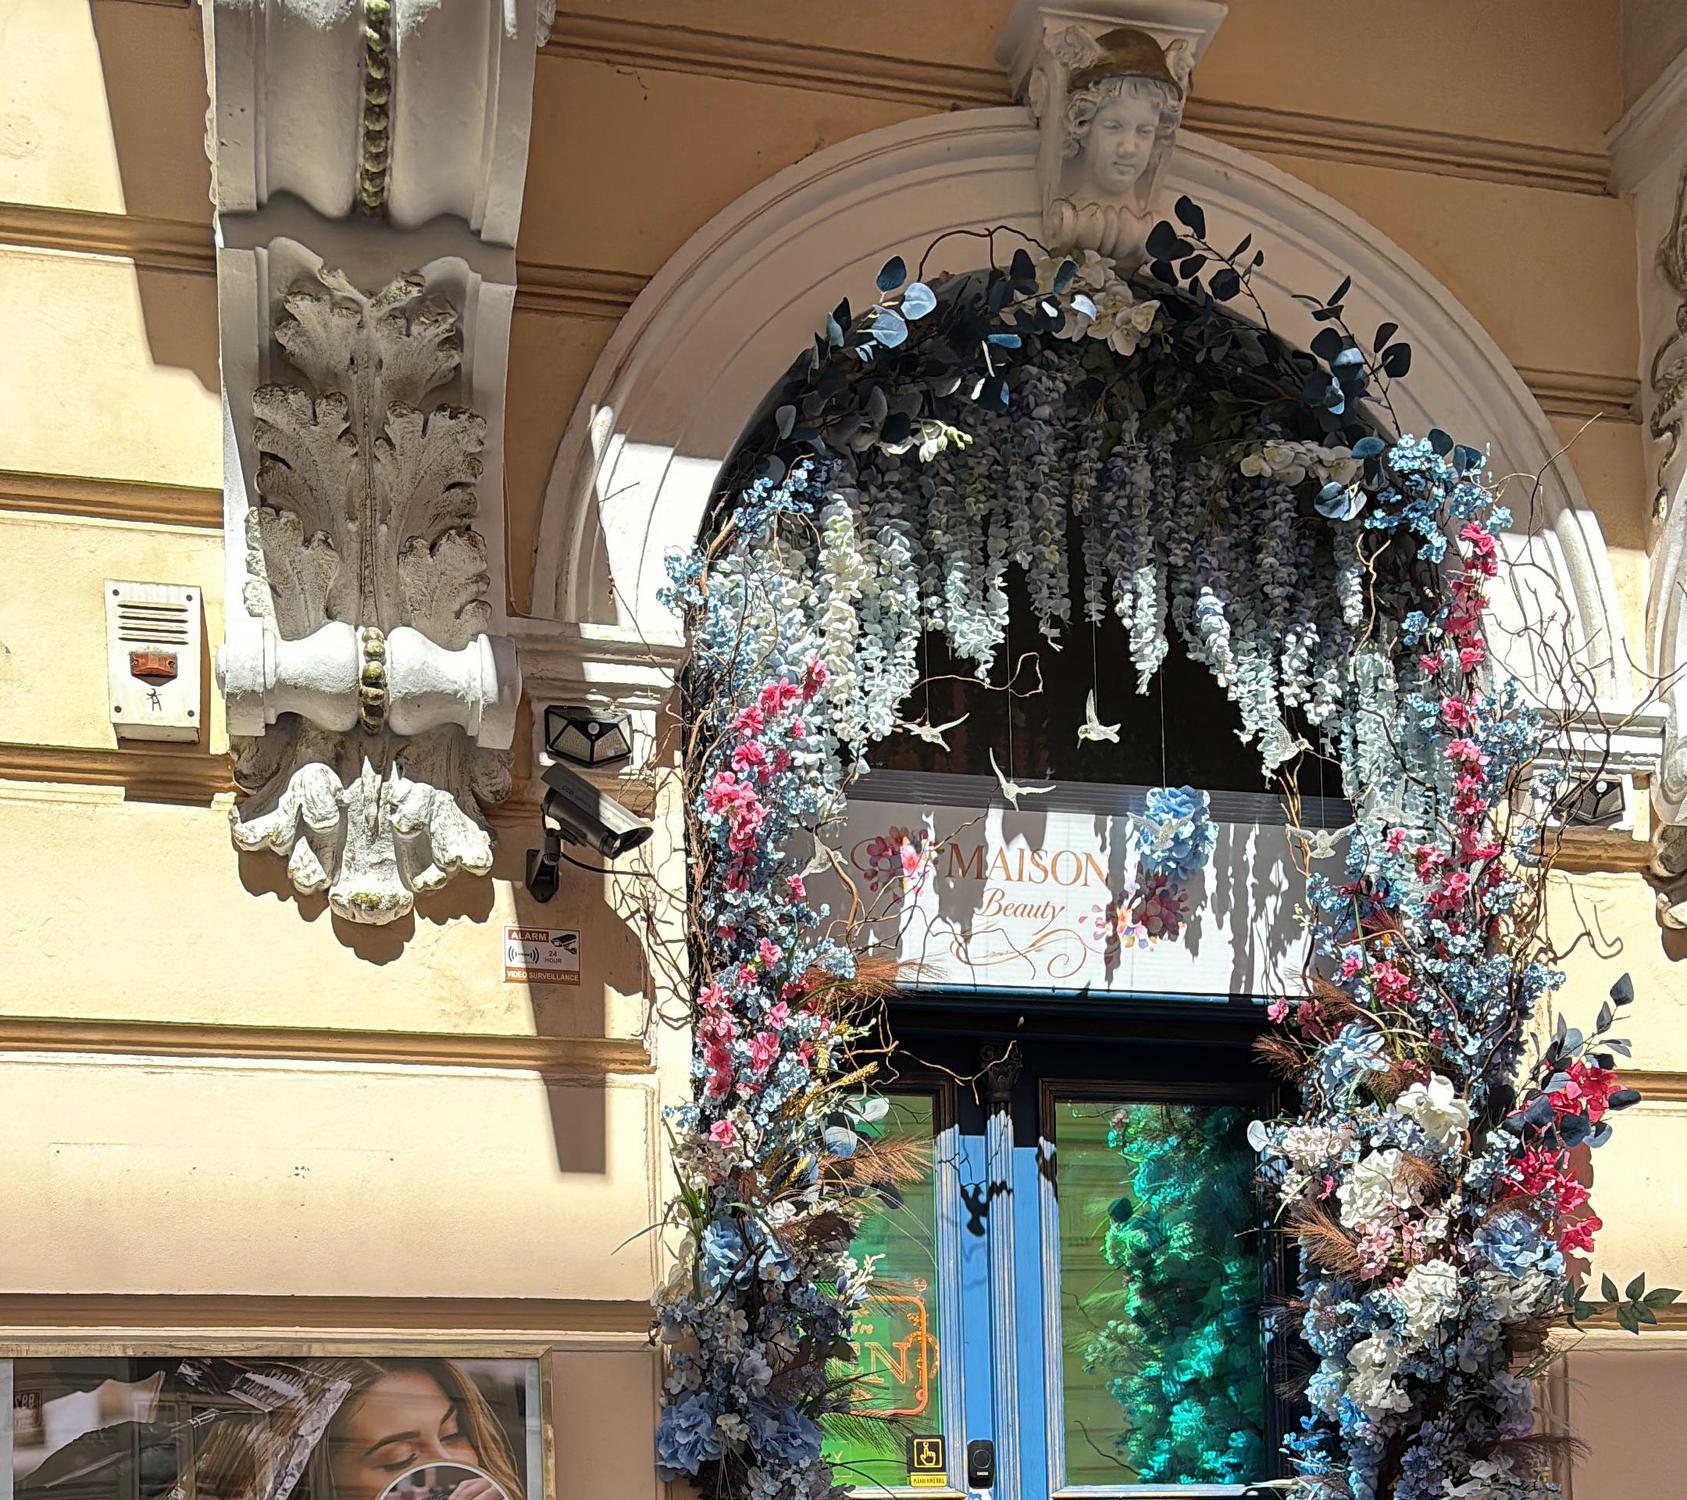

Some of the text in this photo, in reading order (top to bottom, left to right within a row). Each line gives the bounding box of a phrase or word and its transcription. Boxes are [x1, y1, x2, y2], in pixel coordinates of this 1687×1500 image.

[945, 842, 1110, 888] MAISON
[974, 887, 1065, 936] Beauty
[511, 931, 547, 941] ALARM
[506, 970, 579, 982] VIDEO SURVEILLANCE
